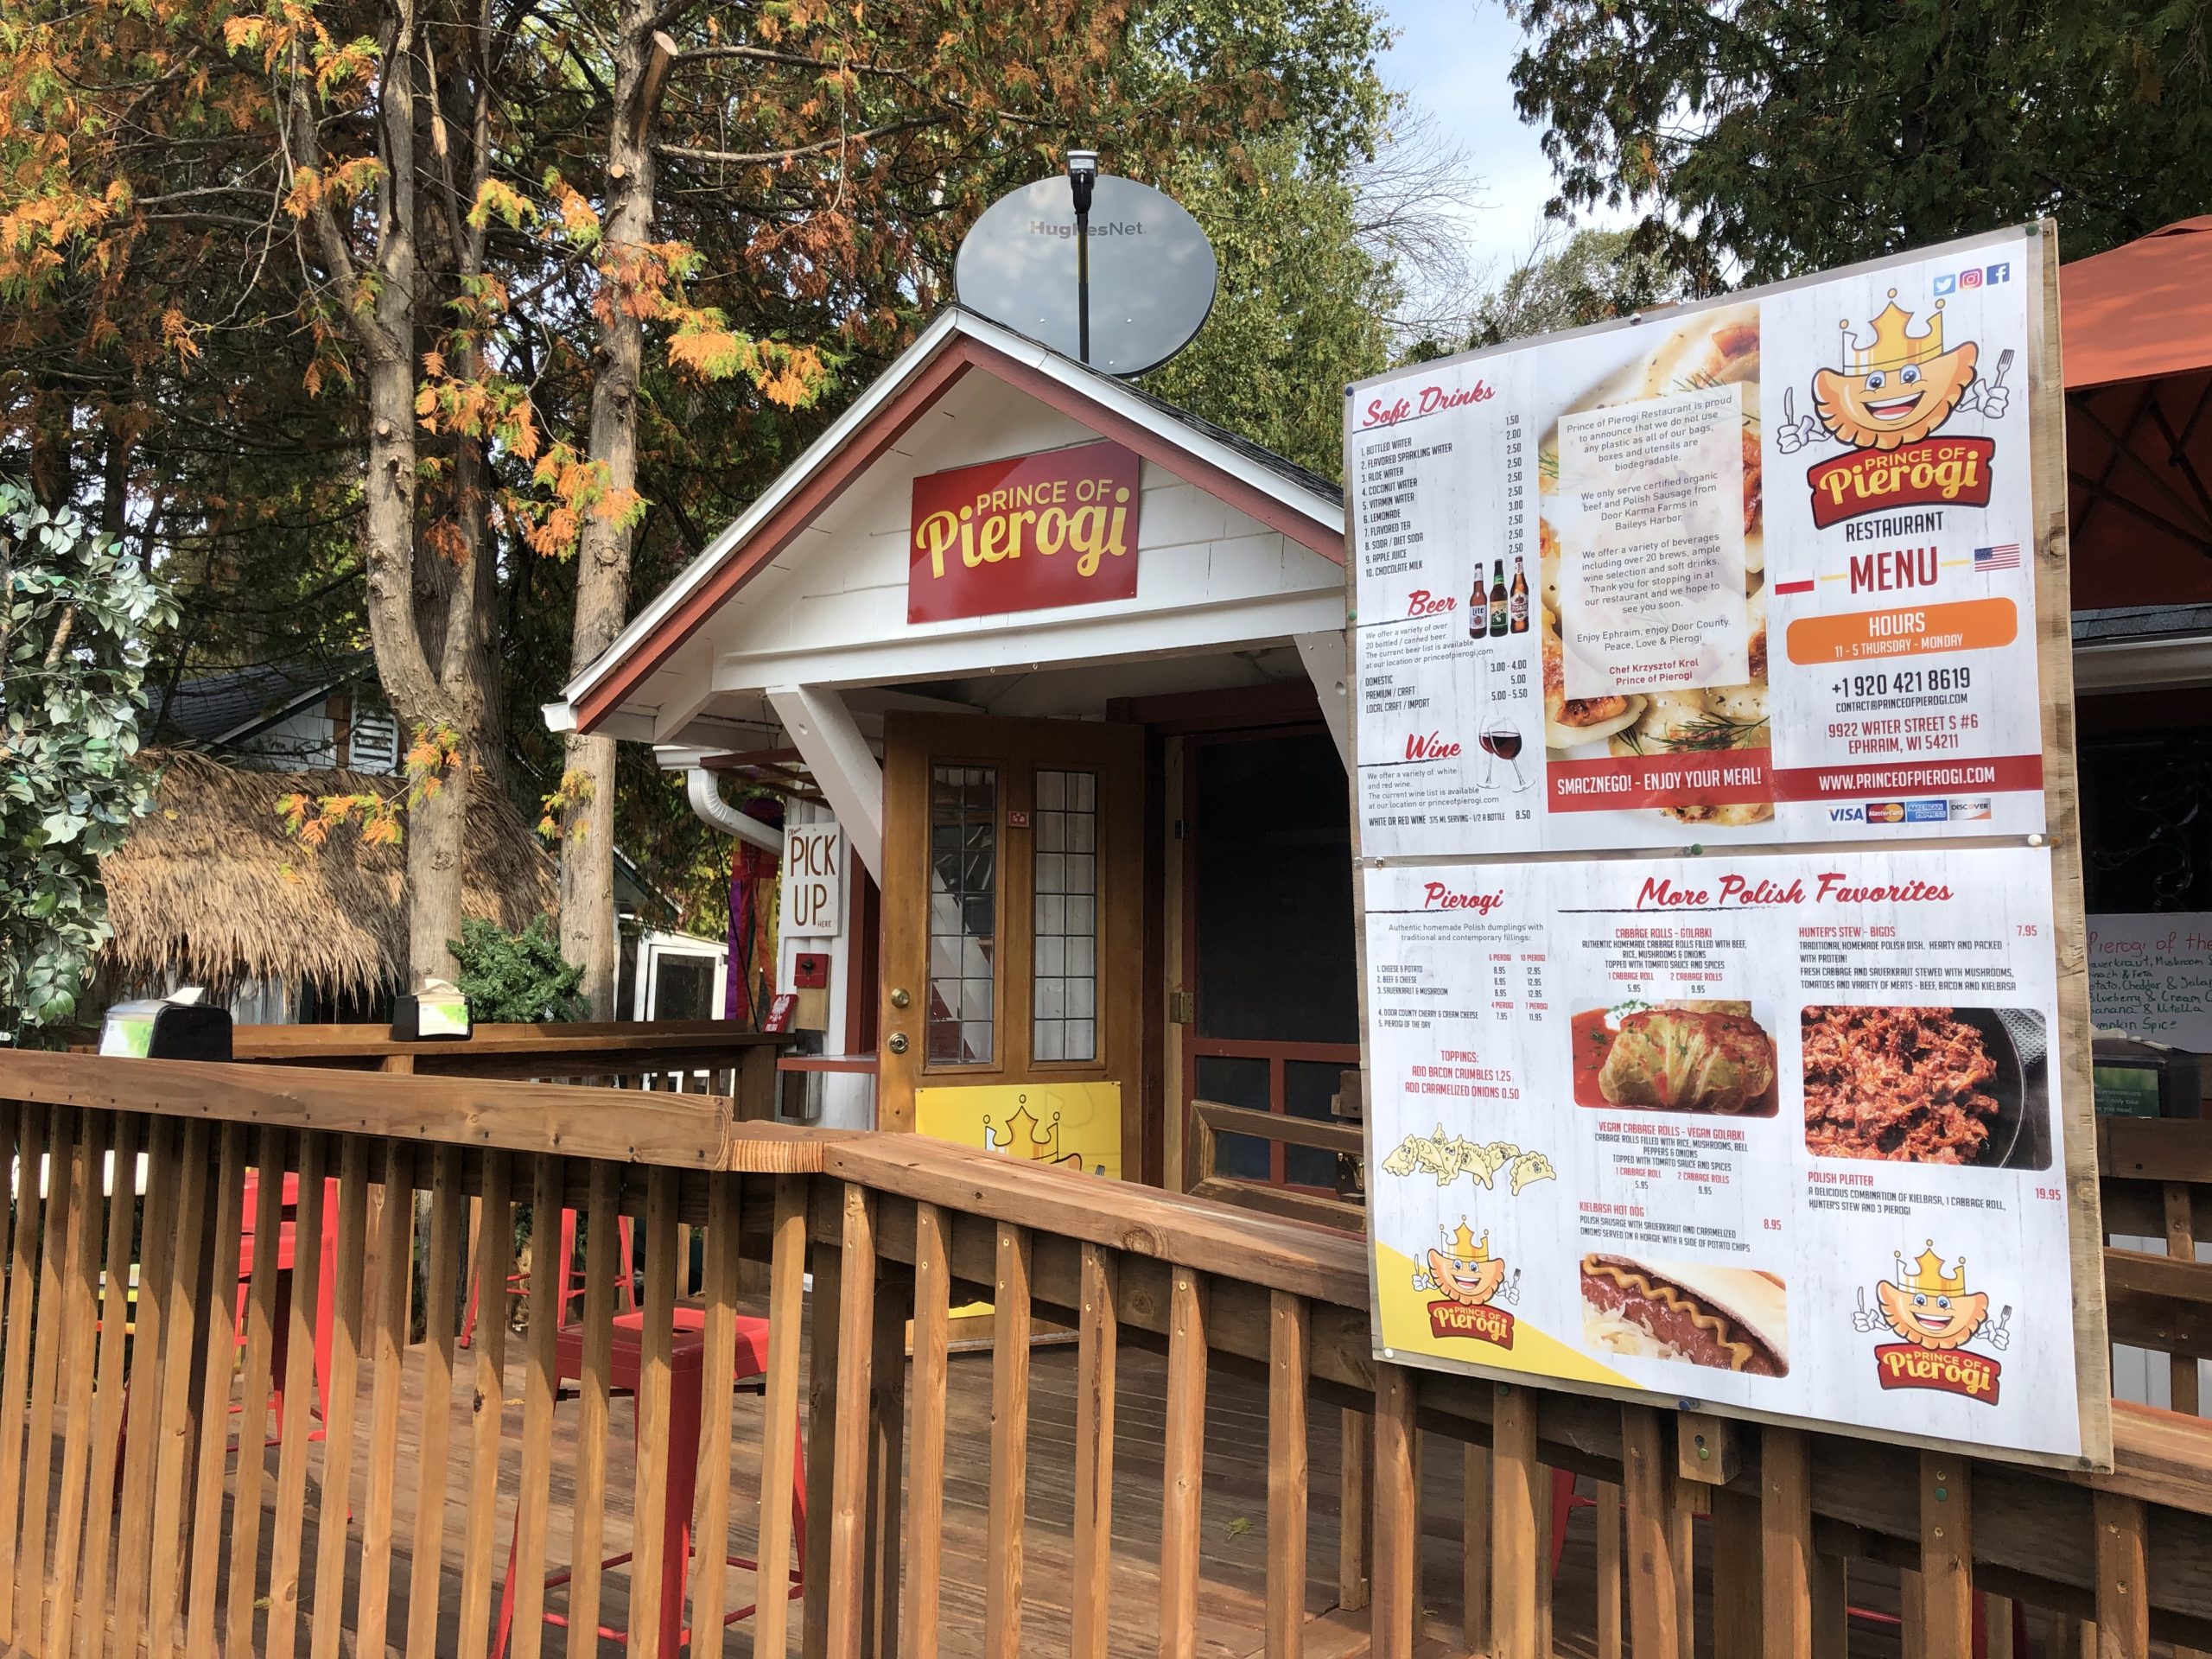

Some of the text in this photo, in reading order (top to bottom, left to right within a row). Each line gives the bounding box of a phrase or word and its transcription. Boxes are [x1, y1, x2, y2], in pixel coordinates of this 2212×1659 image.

[1362, 380, 1496, 428] Soft Drinks
[1506, 415, 1519, 425] 1.50
[1567, 423, 1594, 433] Prince
[1597, 419, 1605, 428] of
[1608, 412, 1639, 426] Pierogi
[1642, 404, 1692, 419] Restaurant
[1705, 396, 1732, 411] proud
[1506, 429, 1521, 440] 2.00
[1366, 442, 1390, 455] BOTTLED
[1392, 438, 1412, 450] WATER
[1507, 443, 1521, 454] 2.50
[1361, 443, 1452, 470] 2. FLAVORED SPARKLING WATER
[1508, 458, 1522, 468] 2.50
[1615, 454, 1681, 471] biodegradable.
[1866, 448, 1966, 470] PRINCE OF
[1508, 472, 1522, 482] 2.50
[1820, 450, 1980, 505] Pierogi
[1508, 486, 1522, 497] 2.50
[1581, 472, 1718, 501] We only serve certified organic
[976, 479, 1113, 516] PRINCE OF
[1509, 500, 1523, 511] 3.00
[1363, 509, 1401, 524] 6. LEMONADE
[1509, 515, 1523, 525] 2.50
[1615, 514, 1683, 532] Baileys Harbor.
[916, 486, 1130, 579] Pierogi
[1509, 529, 1522, 539] 2.50
[1846, 511, 1944, 542] RESTAURANT
[1509, 543, 1523, 554] 2.50
[1375, 563, 1408, 576] CHOCOLATE
[1409, 560, 1423, 572] MILK
[1850, 546, 1938, 594] MENU
[1408, 590, 1457, 617] Beer
[1869, 613, 1926, 637] HOURS
[1835, 633, 1963, 658] 11 5 THURSDAY MONDAY
[1491, 660, 1526, 672] 3.00 4.00
[1609, 658, 1699, 676] Chef Krzysztof Krol
[1365, 676, 1393, 687] DOMESTIC
[1511, 674, 1526, 684] 5.00
[1616, 671, 1692, 686] Prince of Pierogi
[1832, 667, 1971, 697] +1 920 421 8619
[1366, 686, 1415, 700] PREMIUM CRAFT
[1491, 689, 1528, 701] 5.00 5.50
[1836, 693, 1967, 713] CONTACT@PRINCEOFPIEROGI.COM
[1828, 714, 1979, 738] 9922 WATER STREET S #6
[1405, 731, 1461, 760] Wine
[1848, 734, 1959, 754] EPHRAIM, WI 54211
[1557, 767, 1762, 795] SMACZNEGO! ENJOY YOUR MEAL!
[1819, 766, 1995, 791] WWW.PRINCEOFPIEROGI.COM
[1516, 810, 1530, 820] 8.50
[1827, 808, 1864, 821] VISA
[791, 835, 836, 877] PICK
[1424, 881, 1503, 916] Pierogi
[1637, 872, 1955, 910] More Polish Favorites
[795, 884, 827, 926] UP
[1487, 924, 1525, 932] dumplings
[1616, 928, 1712, 938] CABBAGE ROLLS GOLABKI
[1799, 926, 1895, 938] HUNTER'S STEW BIGOS
[2017, 925, 2037, 936] 7.95
[2157, 932, 2176, 953] of
[1800, 954, 1816, 963] WITH
[2088, 956, 2152, 968] auerkraut,
[1628, 984, 1641, 993] 5.95
[1441, 1051, 1479, 1063] TOPPINGS:
[1412, 1066, 1511, 1081] ADD BACON CRUMBLES 1.25
[1405, 1083, 1519, 1099] ADD CARAMELIZED ONIONS 0.50
[1599, 1122, 1745, 1141] VEGAN CABBAGE ROLLS VEGAN GOLABKI
[1808, 1172, 1873, 1186] POLISH PLATTER
[2035, 1188, 2061, 1200] 19.95
[1580, 1202, 1644, 1217] KIELBASA HOT DOG
[1764, 1219, 1781, 1230] 8.95
[1455, 1306, 1486, 1317] PRINCE
[1433, 1307, 1507, 1340] Pierogi
[1914, 1351, 1981, 1368] PRINCE OF
[1883, 1351, 1991, 1394] Pierogi
